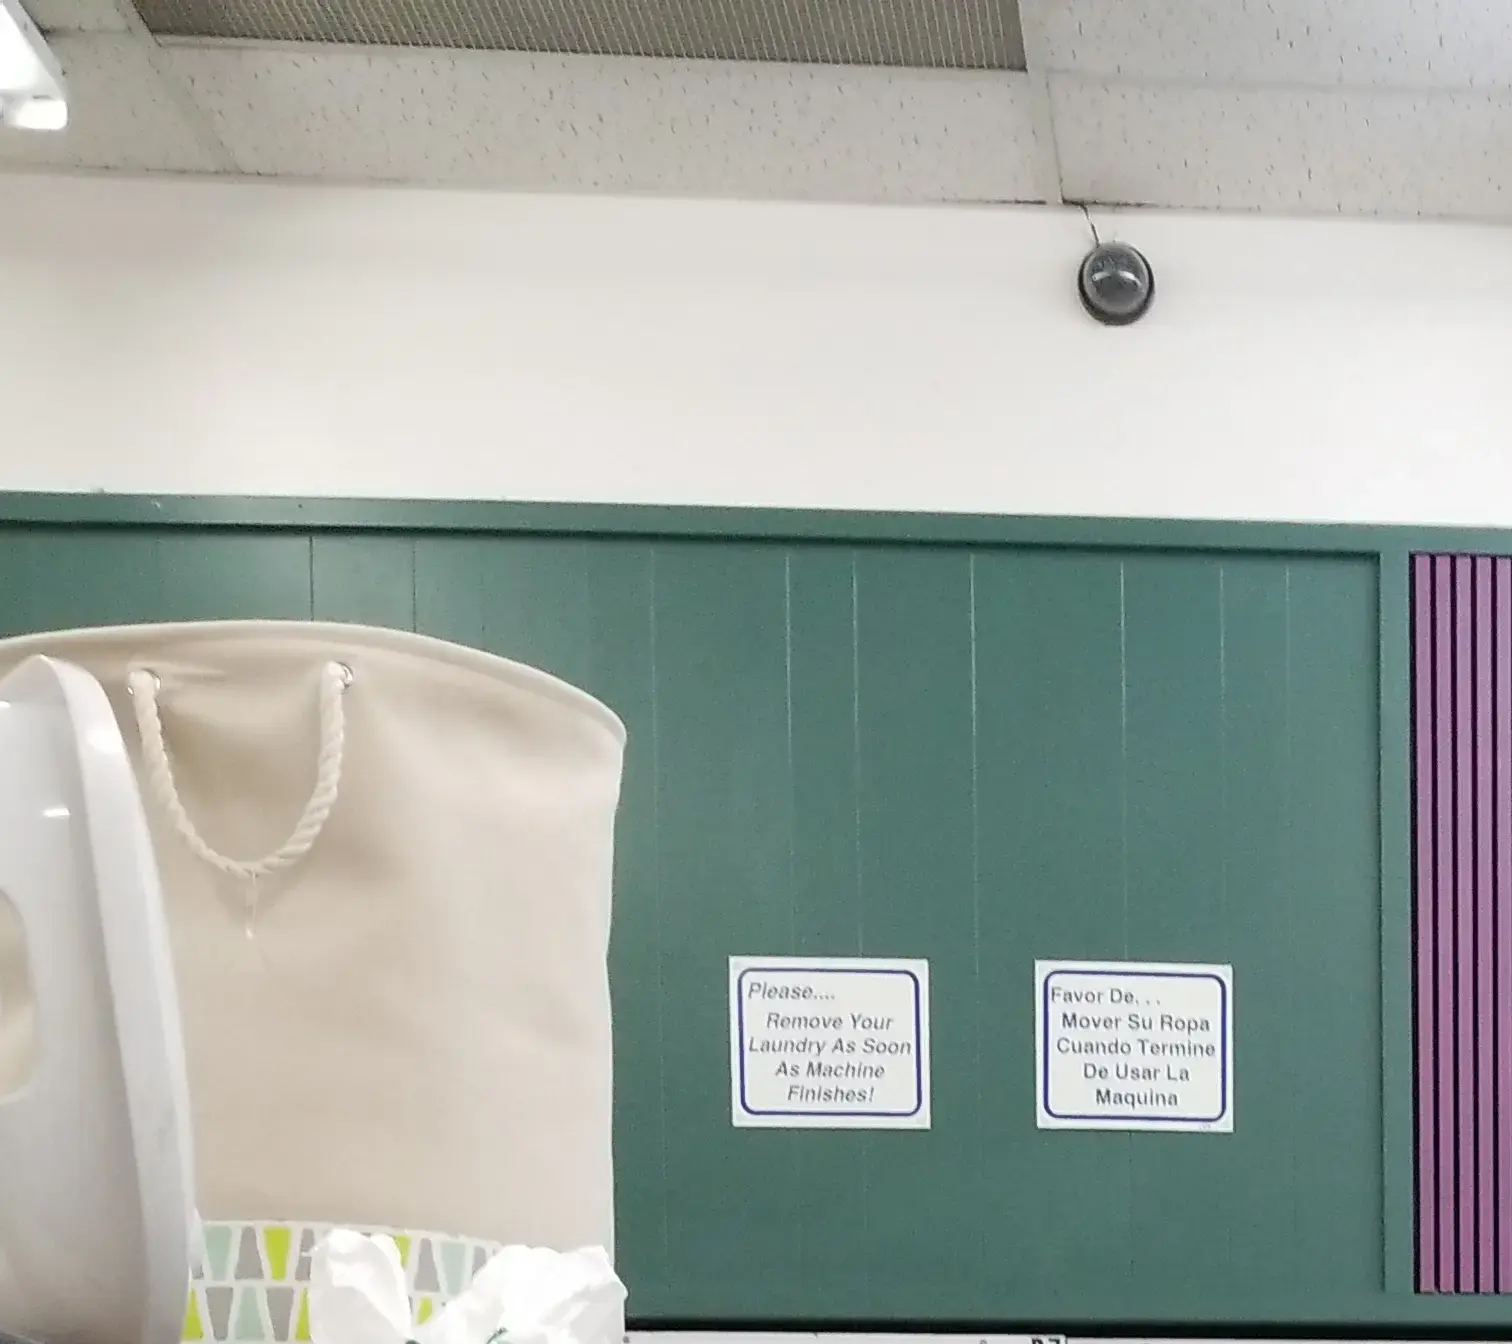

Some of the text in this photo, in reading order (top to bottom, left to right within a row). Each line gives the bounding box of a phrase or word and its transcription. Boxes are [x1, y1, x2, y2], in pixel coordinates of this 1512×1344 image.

[1051, 986, 1104, 1003] Favor
[766, 1011, 894, 1031] Remove Your
[1061, 1012, 1210, 1036] Mover Su Ropa
[749, 1036, 912, 1056] Laundry As Soon
[1056, 1037, 1216, 1057] Cuando Termine
[775, 1060, 886, 1079] As Machine
[1083, 1062, 1190, 1082] De Usar La
[787, 1084, 875, 1103] Finishes!
[1095, 1088, 1179, 1110] Maquina
